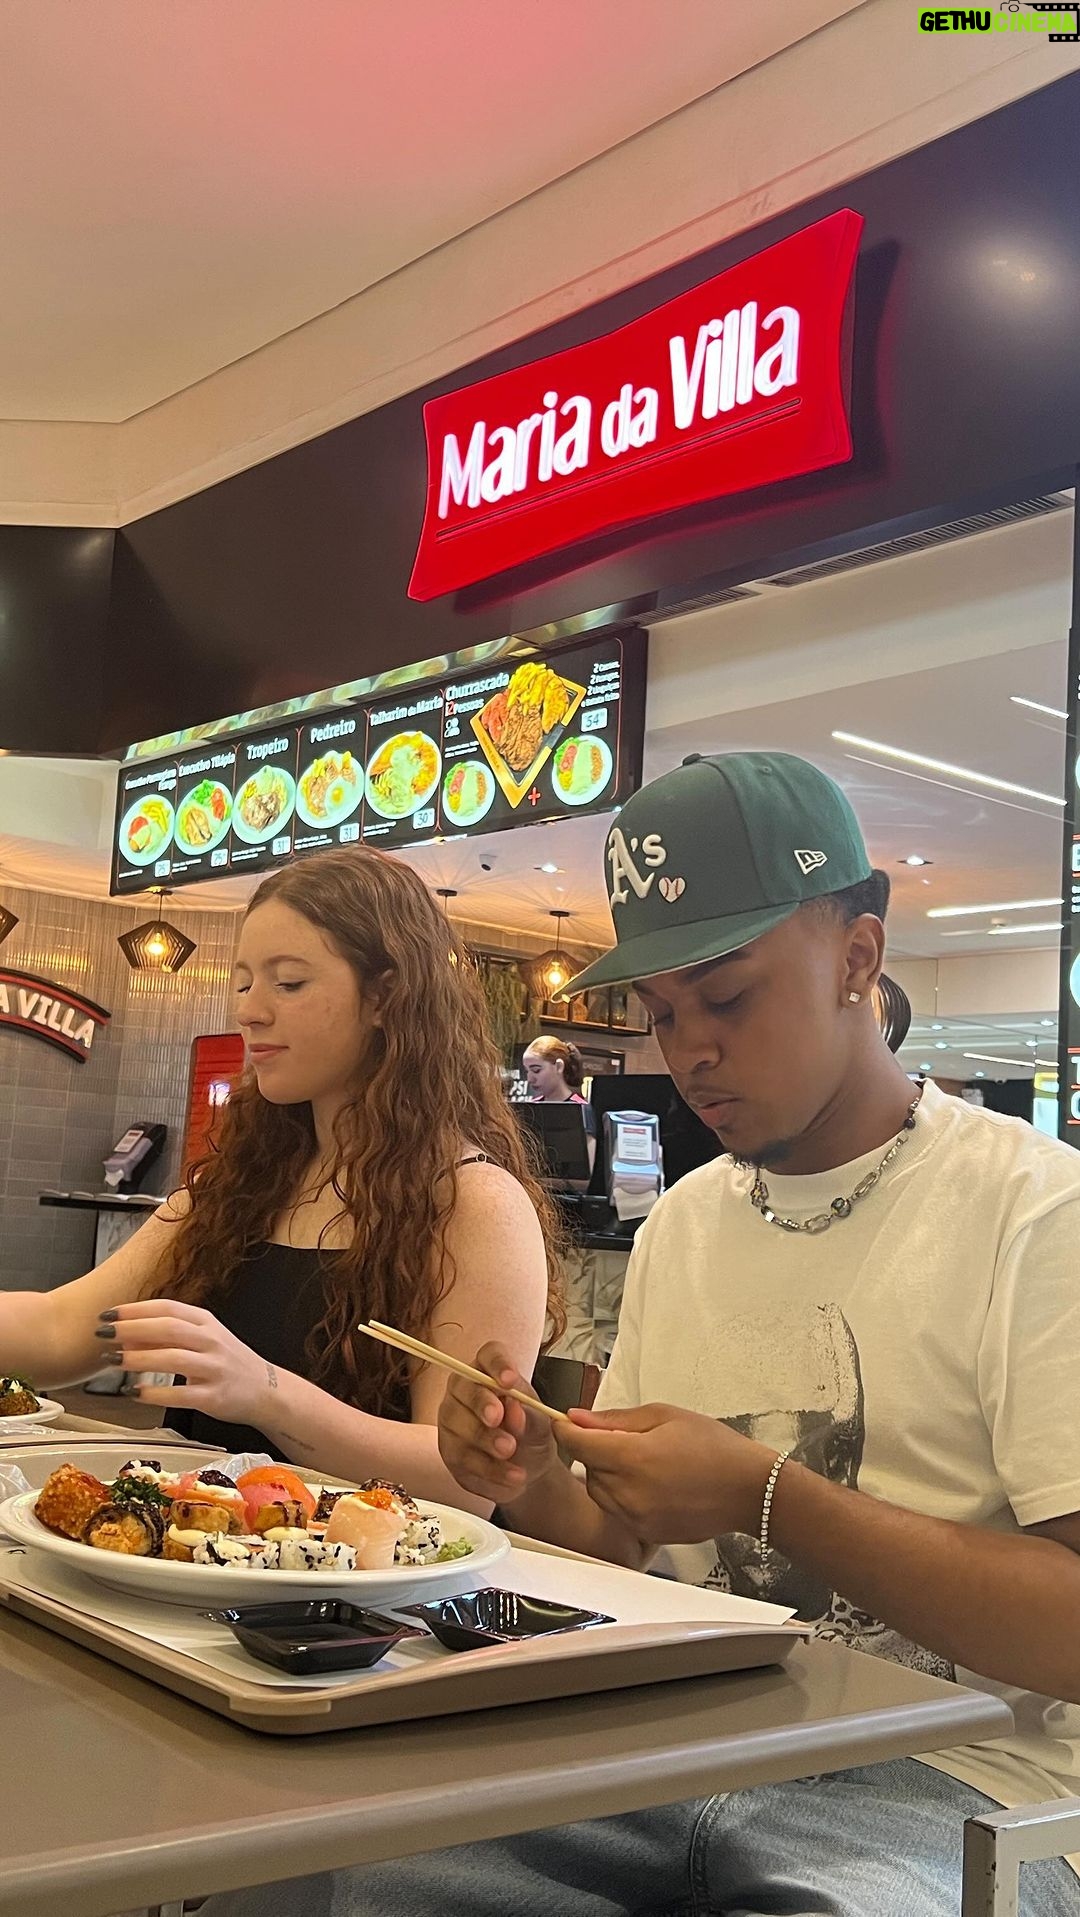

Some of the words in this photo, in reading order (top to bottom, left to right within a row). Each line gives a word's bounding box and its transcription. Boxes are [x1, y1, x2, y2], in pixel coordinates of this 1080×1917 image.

[438, 391, 592, 519] Maria
[600, 383, 658, 458] da
[669, 300, 800, 429] Villa
[445, 672, 510, 701] Churrascada
[370, 706, 408, 727] Talharim
[417, 696, 444, 714] Maria
[310, 719, 356, 744] Pedreiro
[247, 737, 289, 761] Tropeiro
[608, 827, 667, 909] A's
[19, 989, 95, 1048] VILLA
